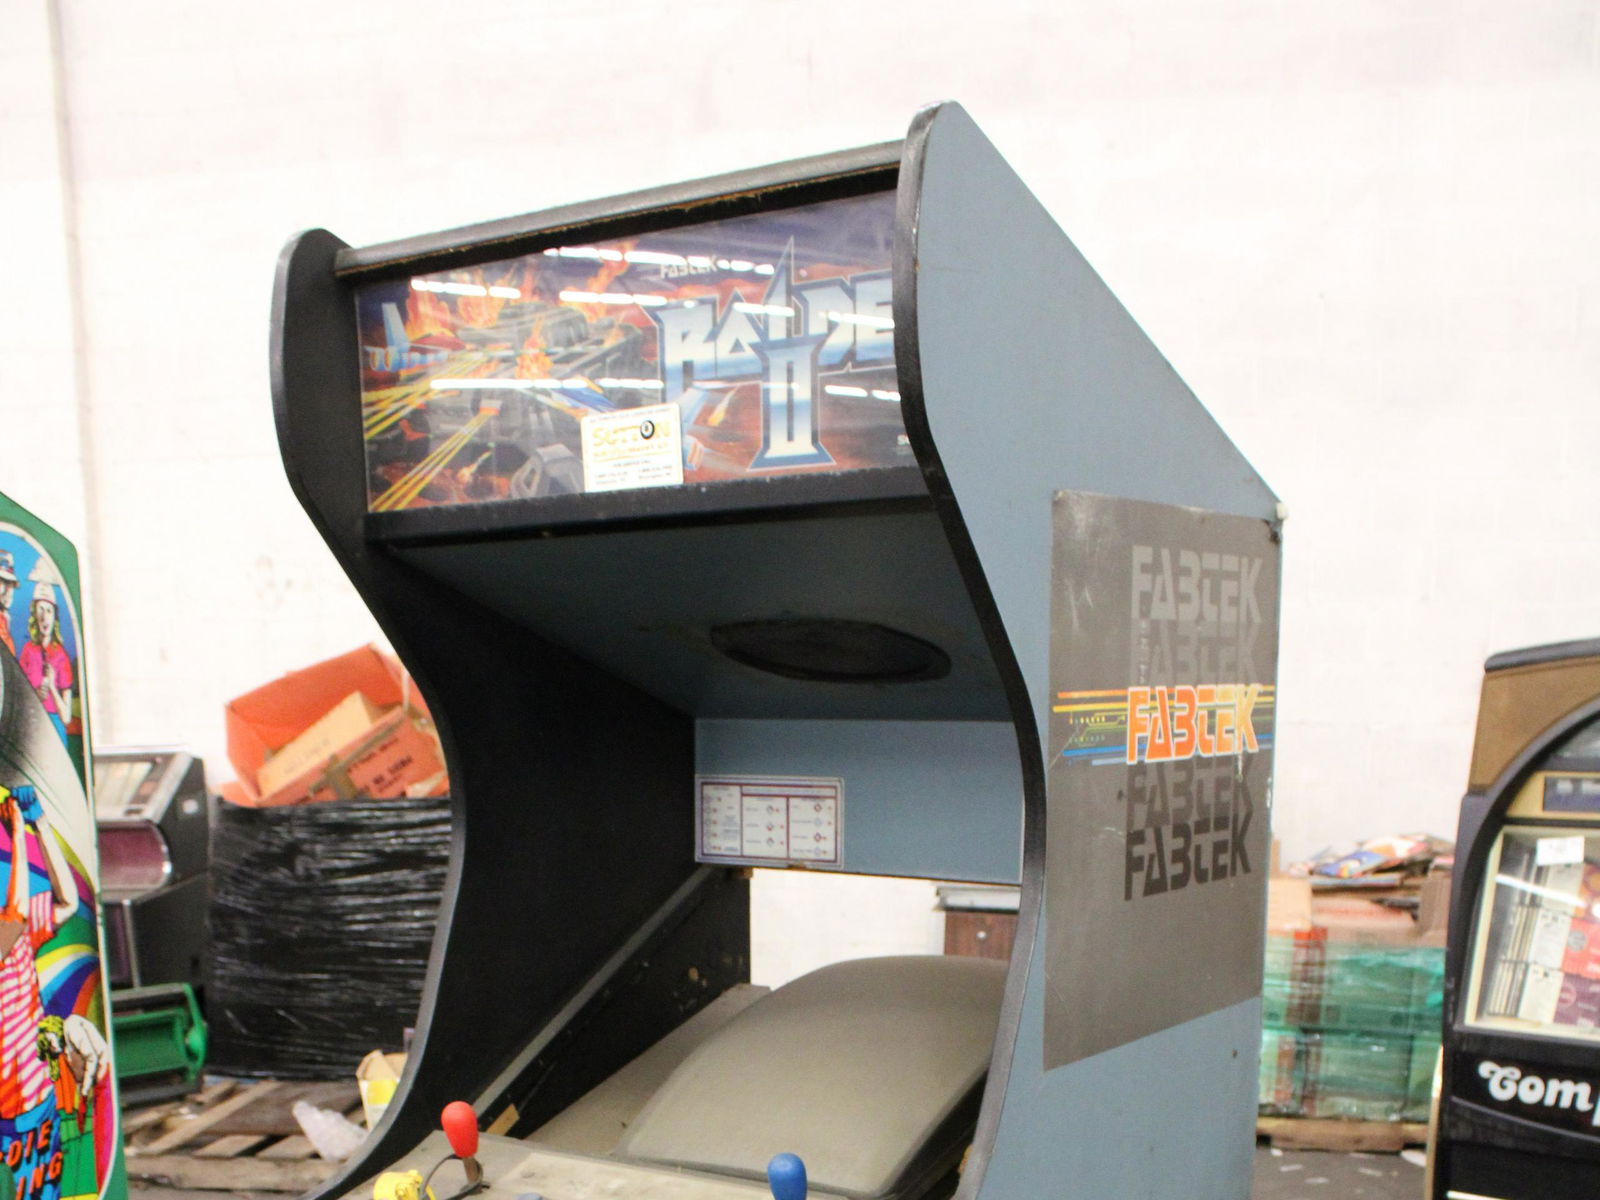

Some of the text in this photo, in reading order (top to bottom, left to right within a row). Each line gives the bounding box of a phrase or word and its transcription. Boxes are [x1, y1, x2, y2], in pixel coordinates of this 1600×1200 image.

[652, 235, 896, 403] RAIDE
[1131, 544, 1264, 623] FABTEK
[1126, 683, 1263, 765] FABTEK
[1124, 815, 1252, 901] FABTEK
[1477, 1060, 1600, 1128] Com
[0, 1118, 53, 1168] DIE
